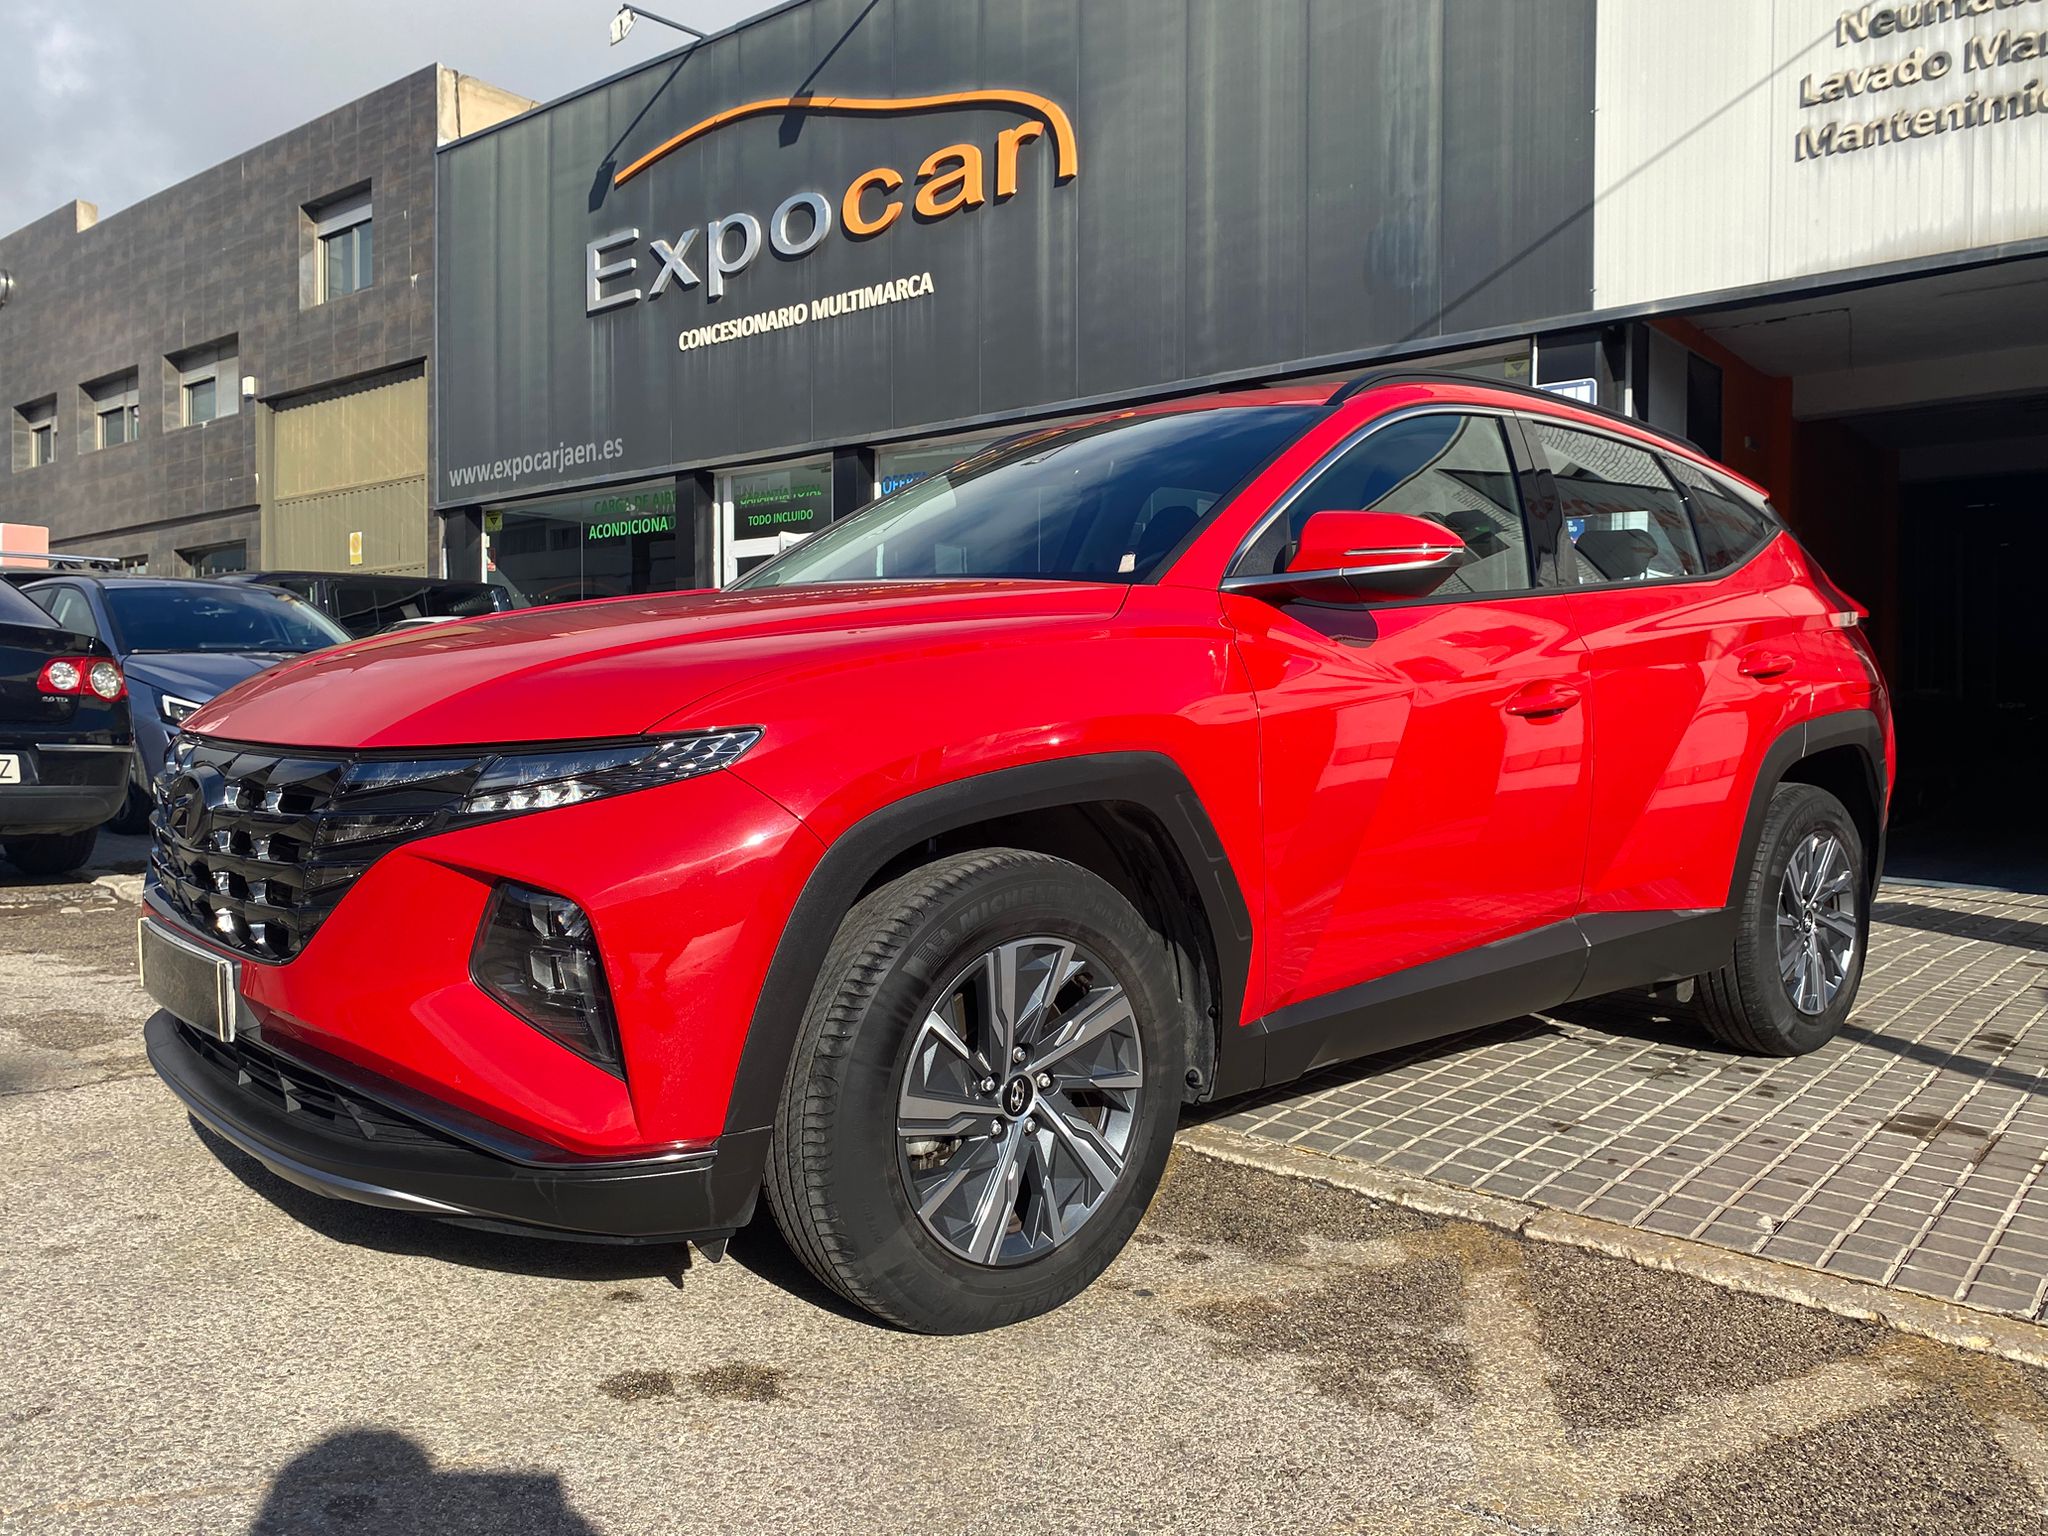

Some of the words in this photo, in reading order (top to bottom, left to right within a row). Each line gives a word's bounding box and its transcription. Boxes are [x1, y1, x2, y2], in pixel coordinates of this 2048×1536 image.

[1800, 47, 1953, 109] Lavado
[1963, 28, 2048, 74] Ma
[586, 119, 1045, 316] Expocar
[678, 302, 809, 351] CONCESIONARIO
[811, 271, 936, 321] MULTIMARCA
[449, 437, 624, 488] www.expocarjaen.es
[748, 513, 772, 527] TODO
[773, 508, 814, 524] INCLUIDO
